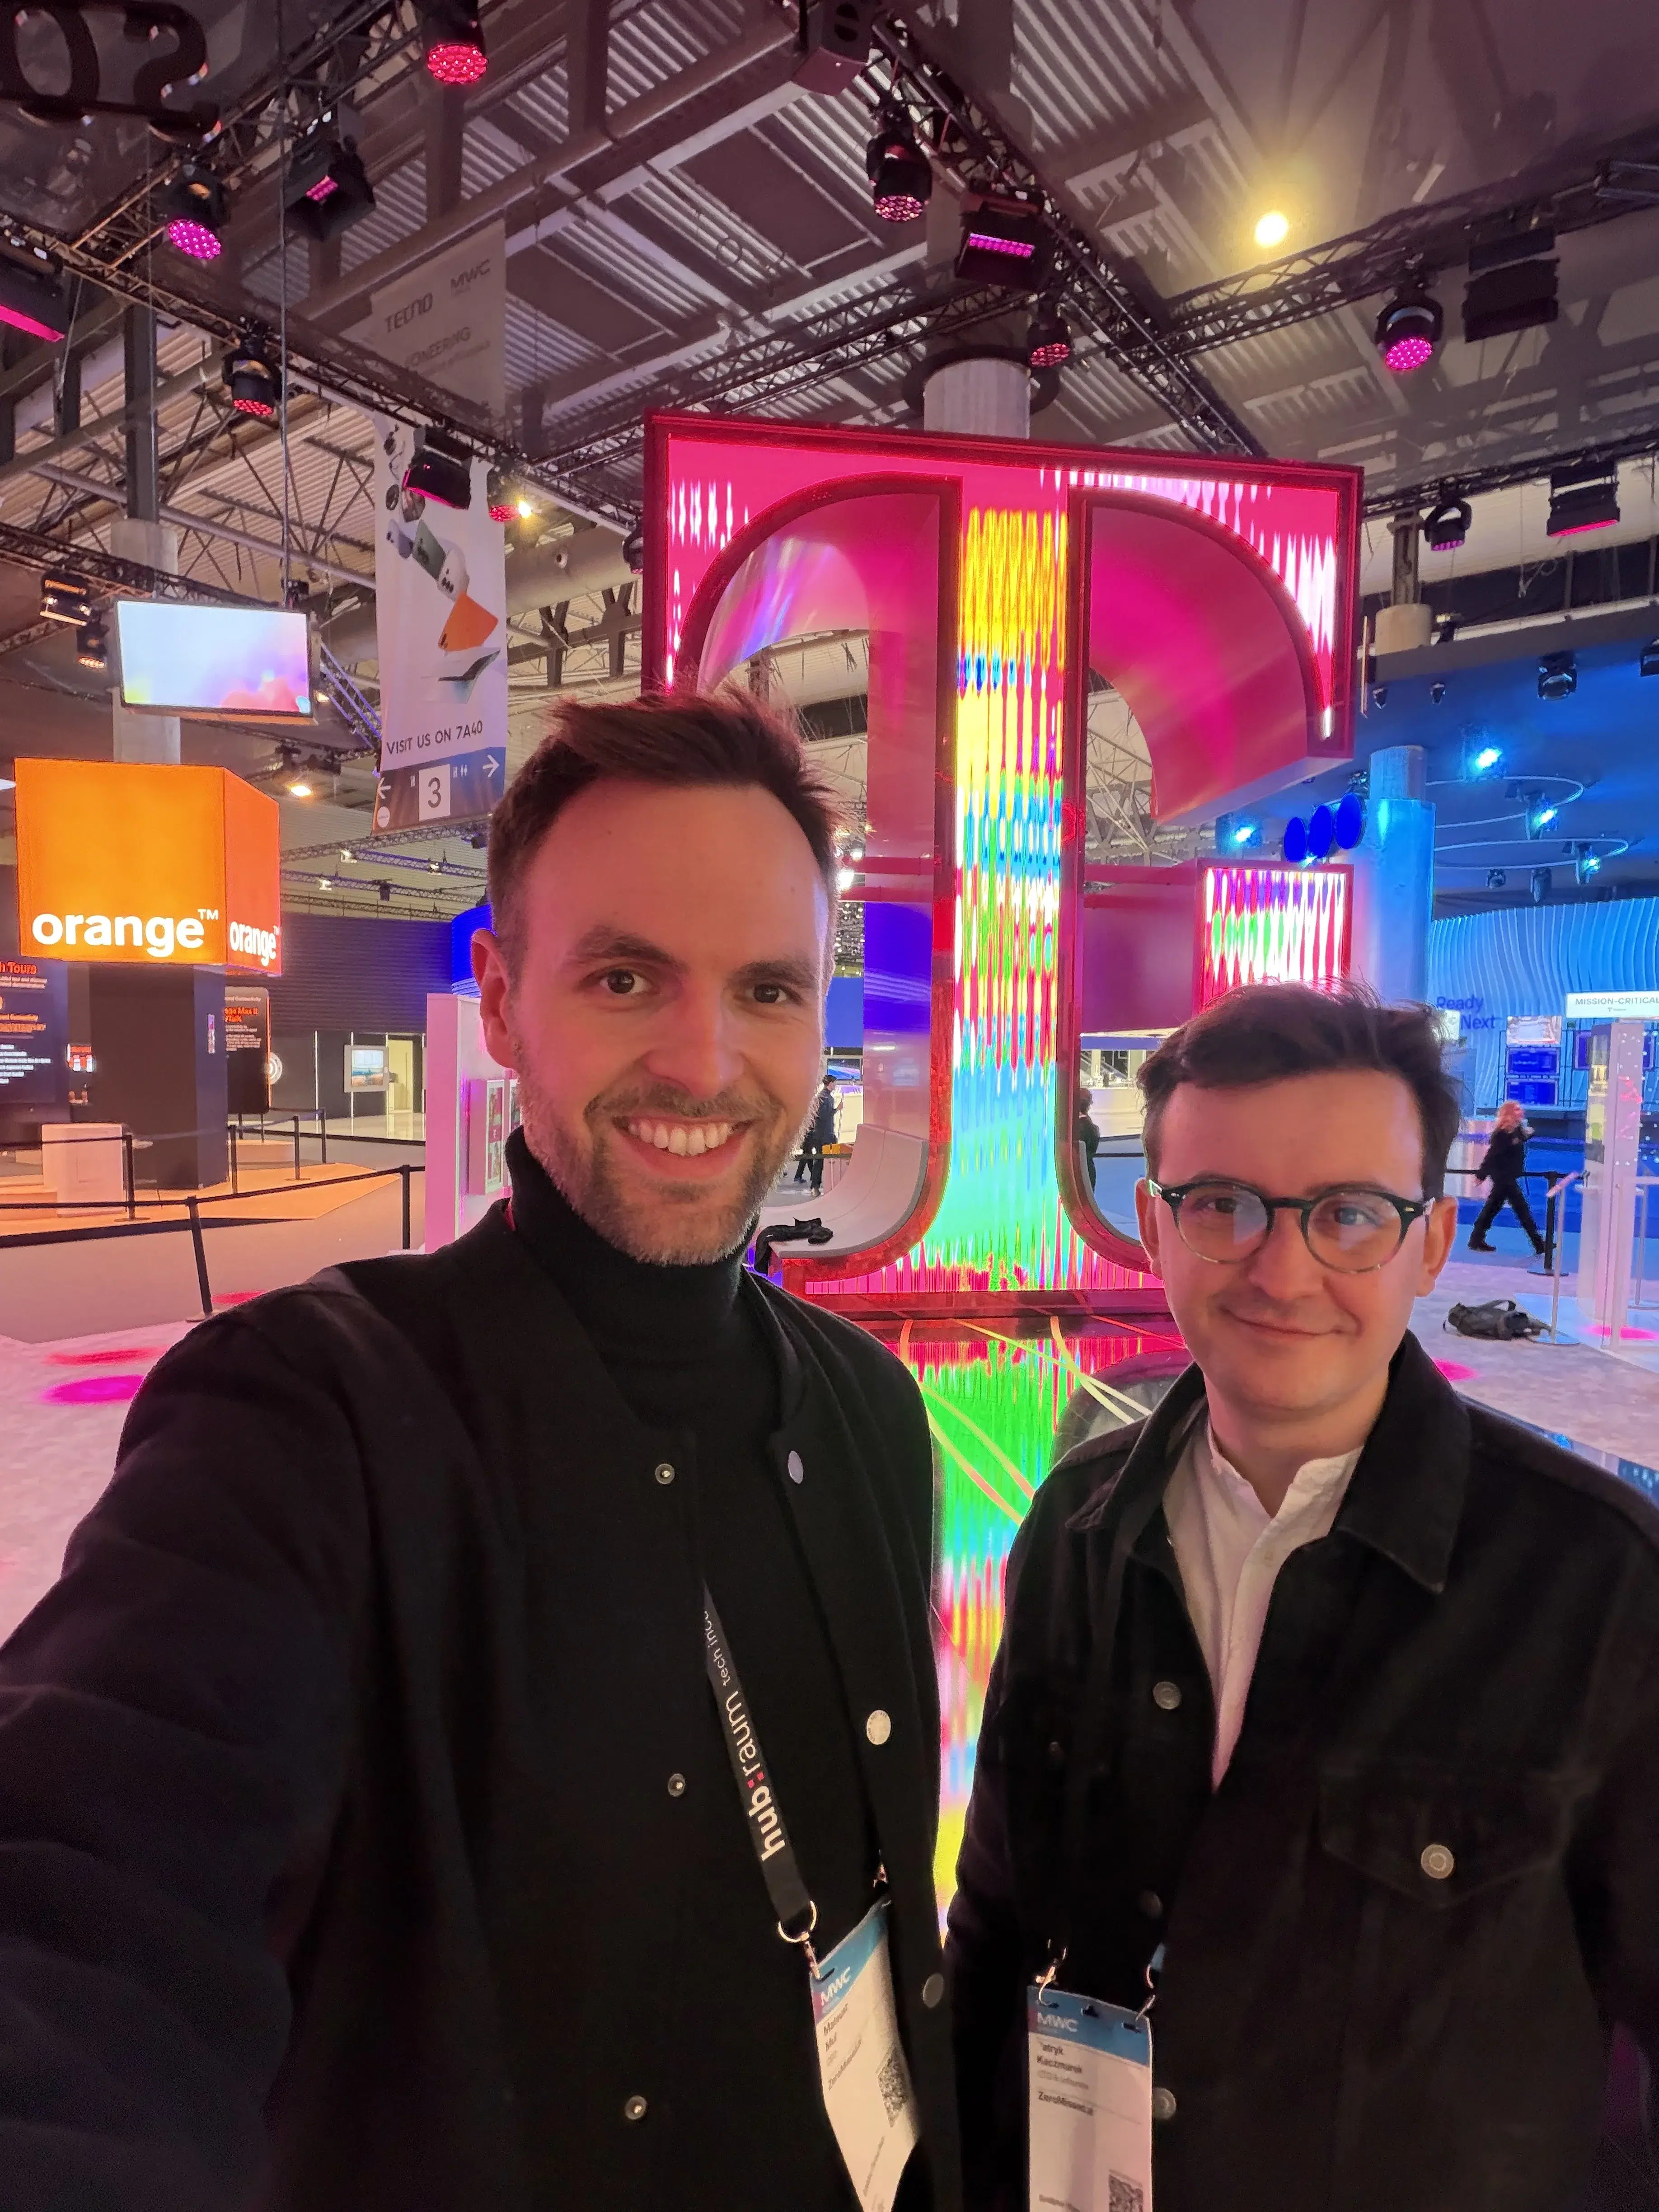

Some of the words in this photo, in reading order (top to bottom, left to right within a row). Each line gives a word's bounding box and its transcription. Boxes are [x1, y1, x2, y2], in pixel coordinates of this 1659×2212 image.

[386, 737, 412, 755] VISIT
[417, 733, 431, 748] US
[435, 727, 451, 744] ON
[455, 720, 483, 740] 7A40
[428, 777, 441, 808] 3
[32, 913, 205, 958] orange
[229, 921, 276, 967] orange
[1436, 994, 1484, 1013] Ready
[1461, 1013, 1495, 1030] Next
[713, 1648, 730, 1687] tech
[820, 1966, 851, 2006] MWC
[1037, 2012, 1079, 2032] MWC
